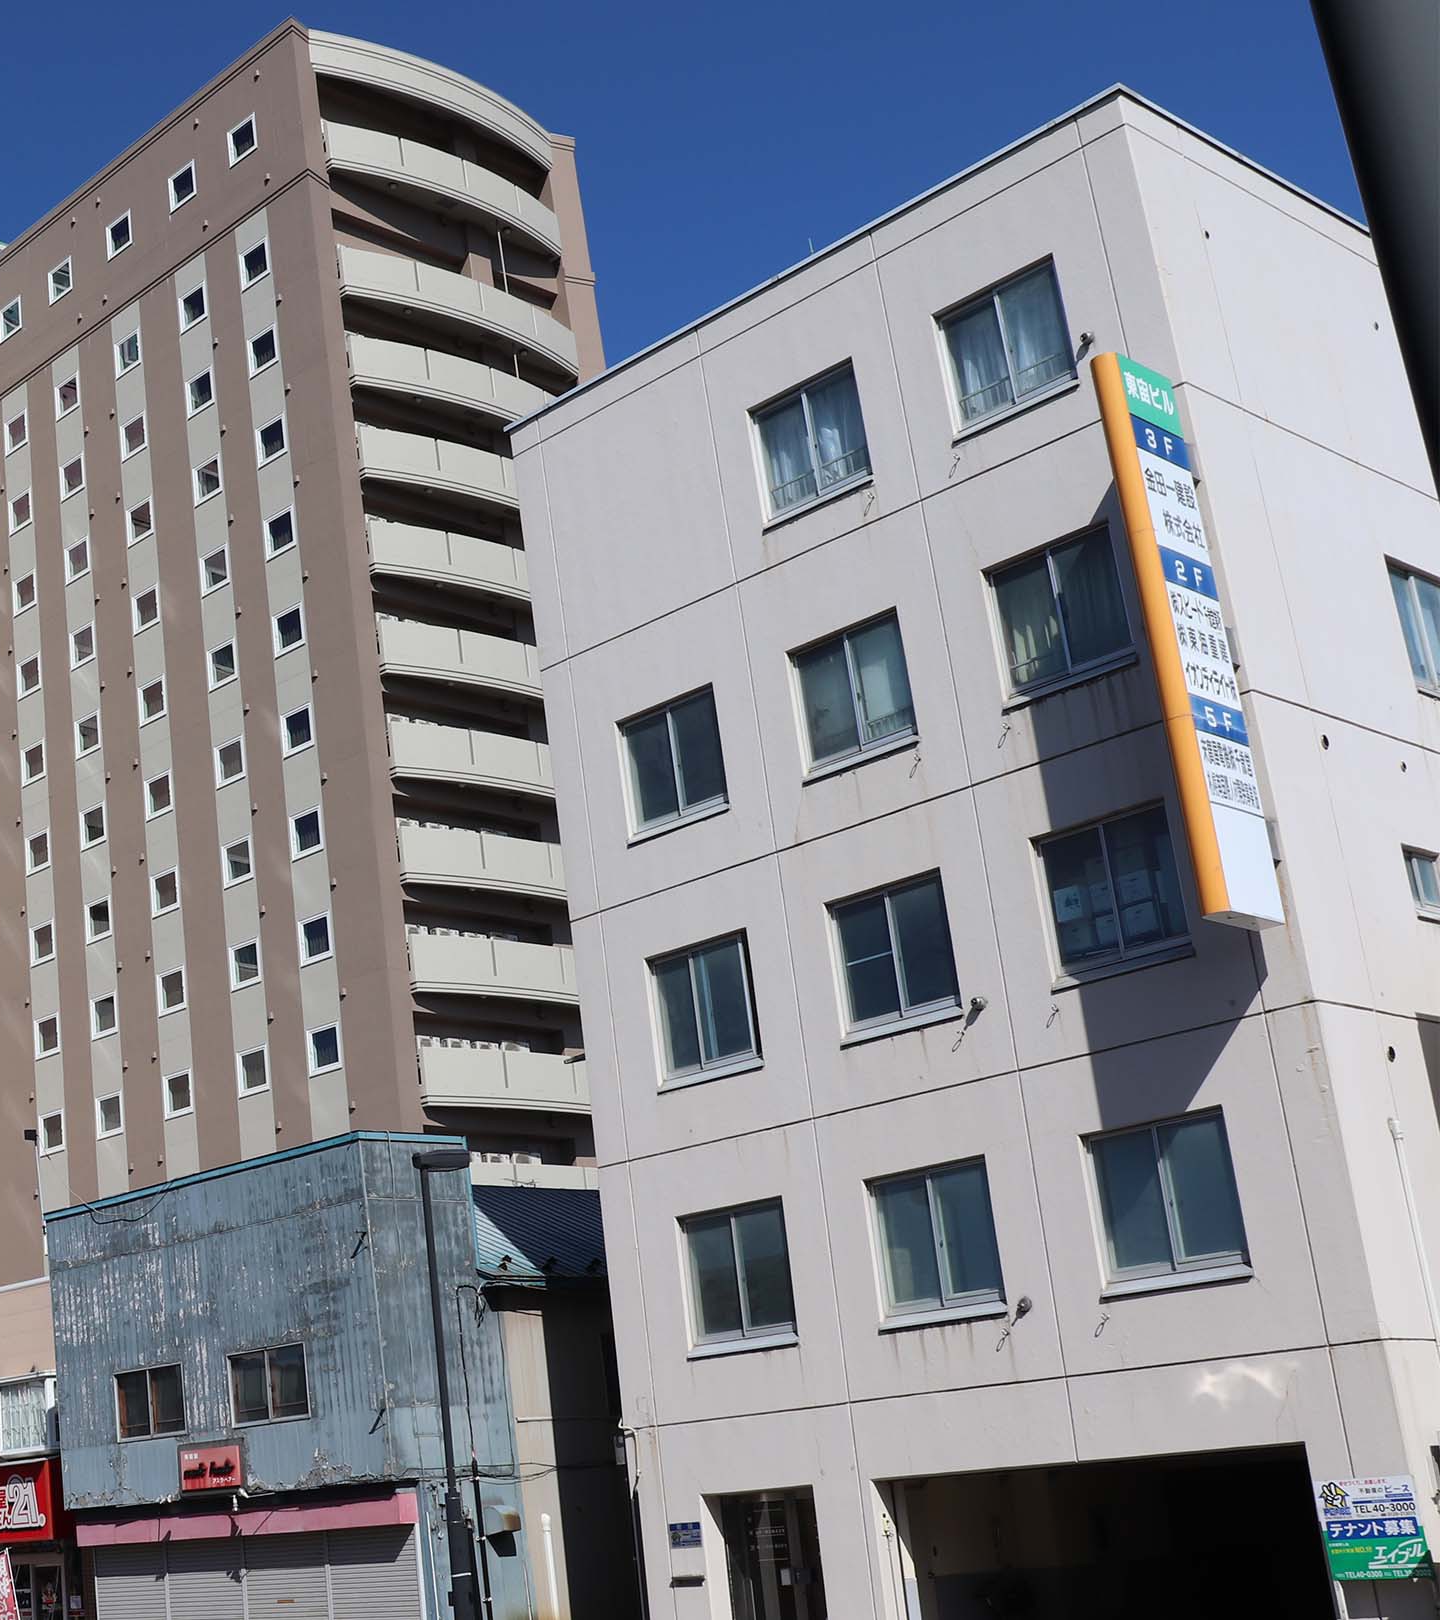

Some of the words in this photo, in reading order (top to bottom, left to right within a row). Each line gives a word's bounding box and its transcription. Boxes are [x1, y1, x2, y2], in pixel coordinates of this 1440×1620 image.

[1161, 510, 1206, 549] 株式会社
[1353, 1505, 1372, 1514] TEL
[1373, 1502, 1416, 1514] 40-3000
[1329, 1519, 1417, 1538] テナント募集
[1369, 1538, 1426, 1564] エイブル
